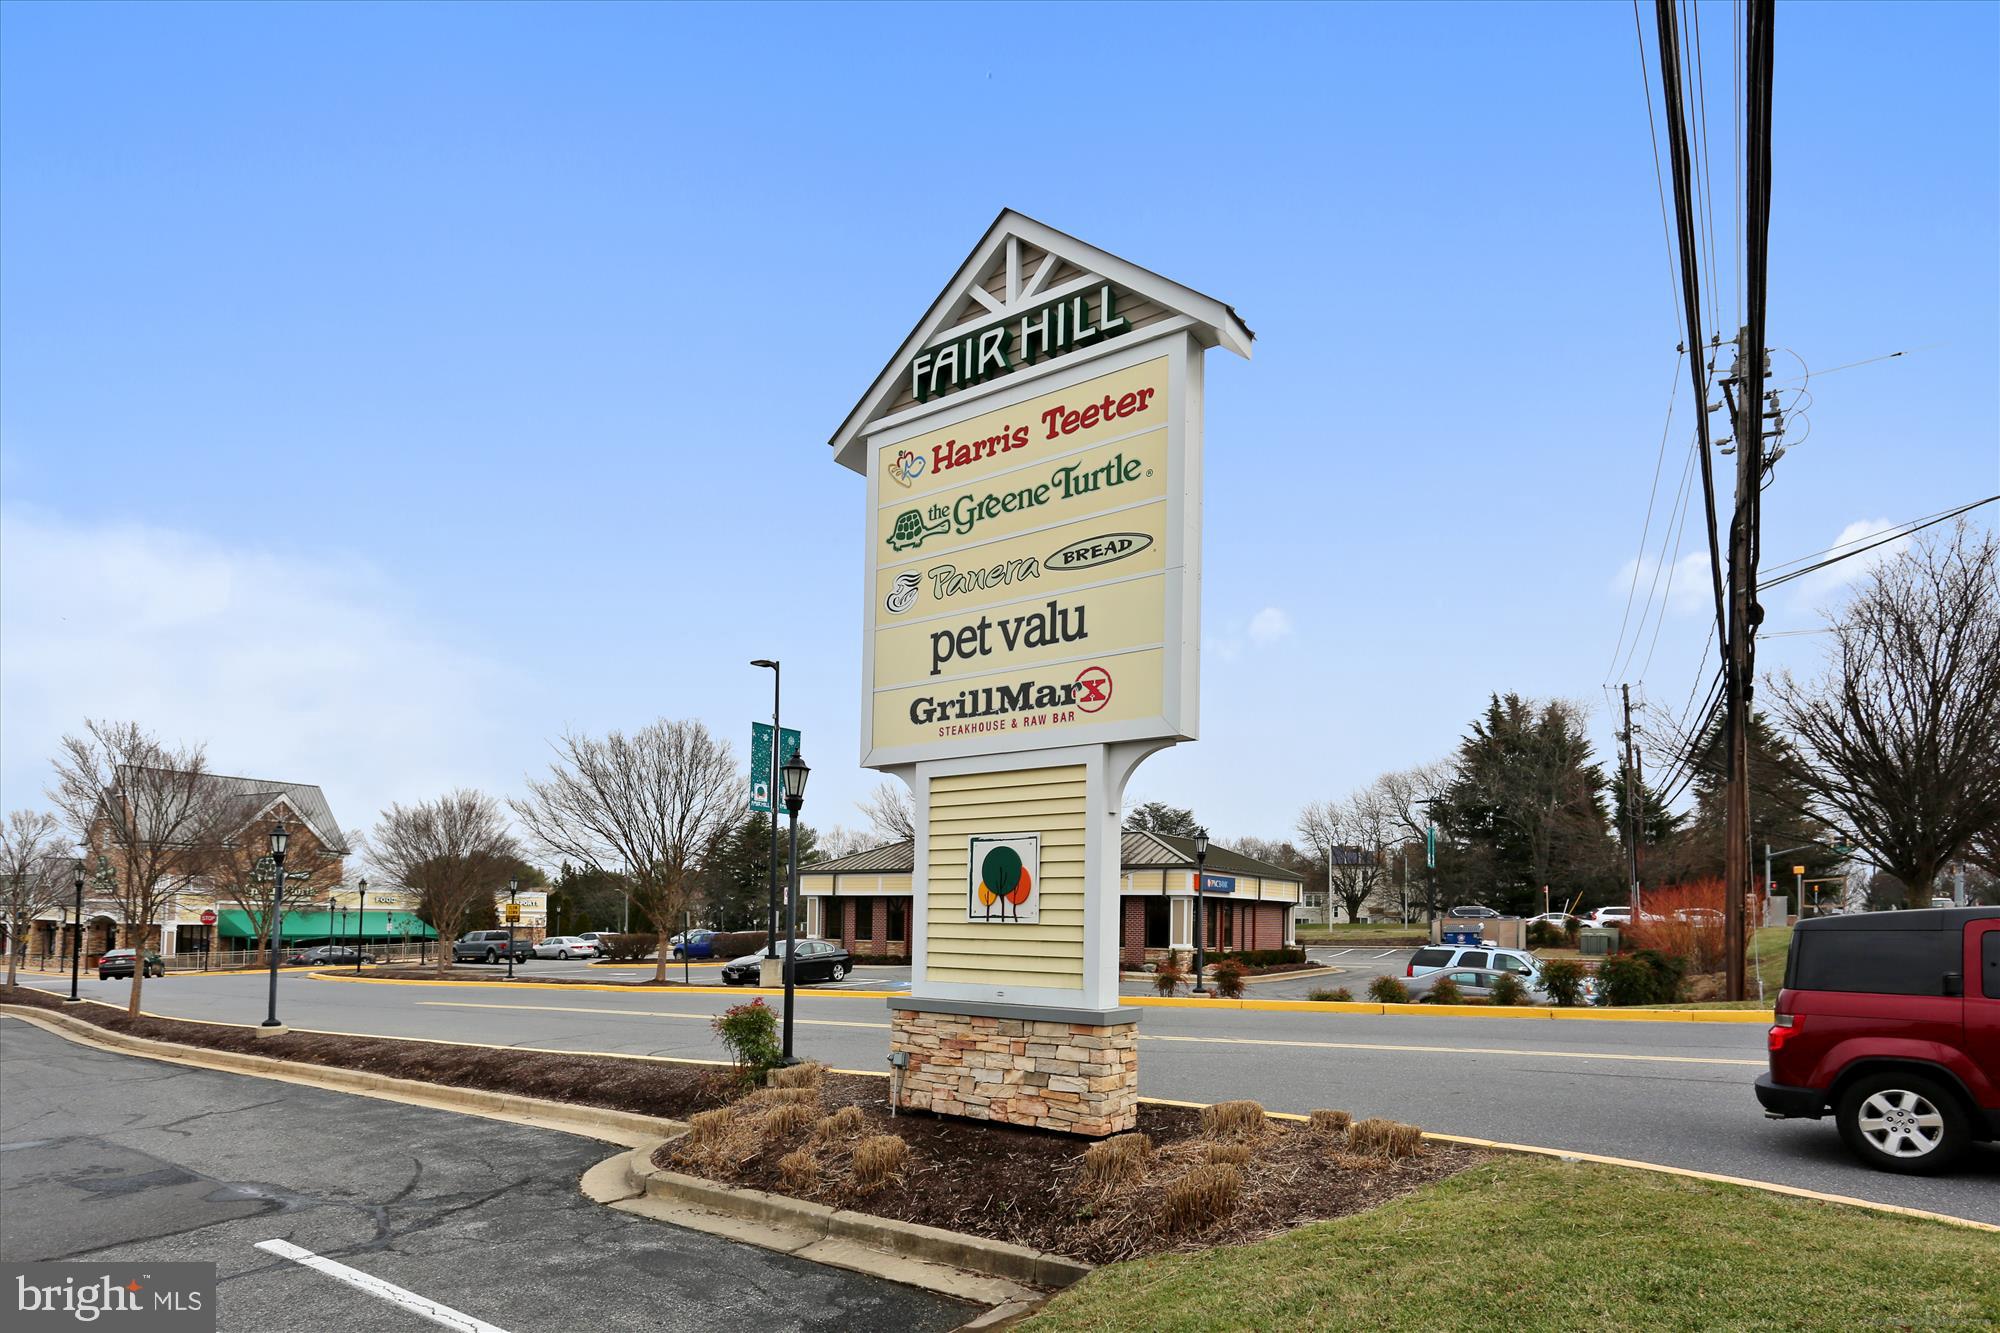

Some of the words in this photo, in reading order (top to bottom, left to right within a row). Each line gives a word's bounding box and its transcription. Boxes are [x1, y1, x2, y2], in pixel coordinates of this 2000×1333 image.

[912, 326, 1010, 402] FAIR
[1020, 285, 1129, 362] HILL
[931, 424, 1029, 475] Harris
[1041, 386, 1155, 440] Teeter
[927, 503, 950, 521] the
[953, 483, 1050, 535] Greene
[1051, 452, 1142, 500] Turtle
[928, 556, 1040, 600] Panera
[1062, 538, 1133, 565] BREAD
[930, 615, 992, 676] pet
[997, 599, 1089, 652] valu
[938, 719, 1006, 738] STEAKHOUSE
[1011, 718, 1018, 729] &
[1023, 714, 1047, 728] RAW
[1052, 711, 1076, 725] BAR
